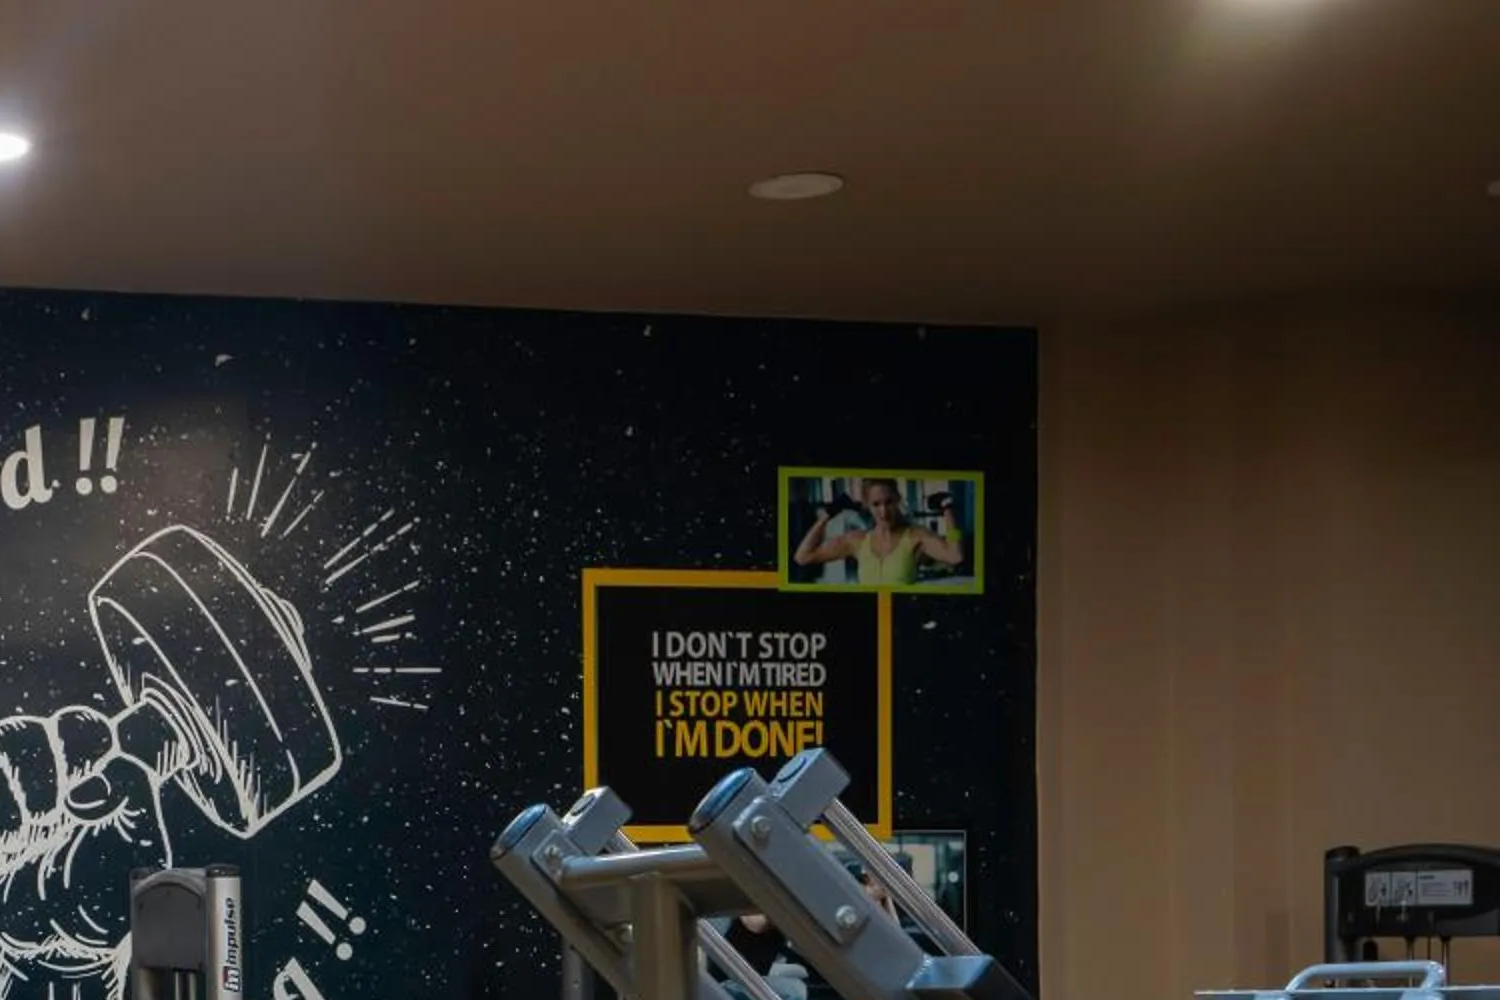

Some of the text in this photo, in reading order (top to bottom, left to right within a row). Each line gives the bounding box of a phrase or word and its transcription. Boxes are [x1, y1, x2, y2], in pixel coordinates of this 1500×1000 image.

[652, 631, 659, 658] I
[758, 632, 827, 659] STOP
[652, 661, 723, 686] WHEN
[761, 662, 827, 687] TIRED
[656, 690, 824, 717] I STOP WHEN
